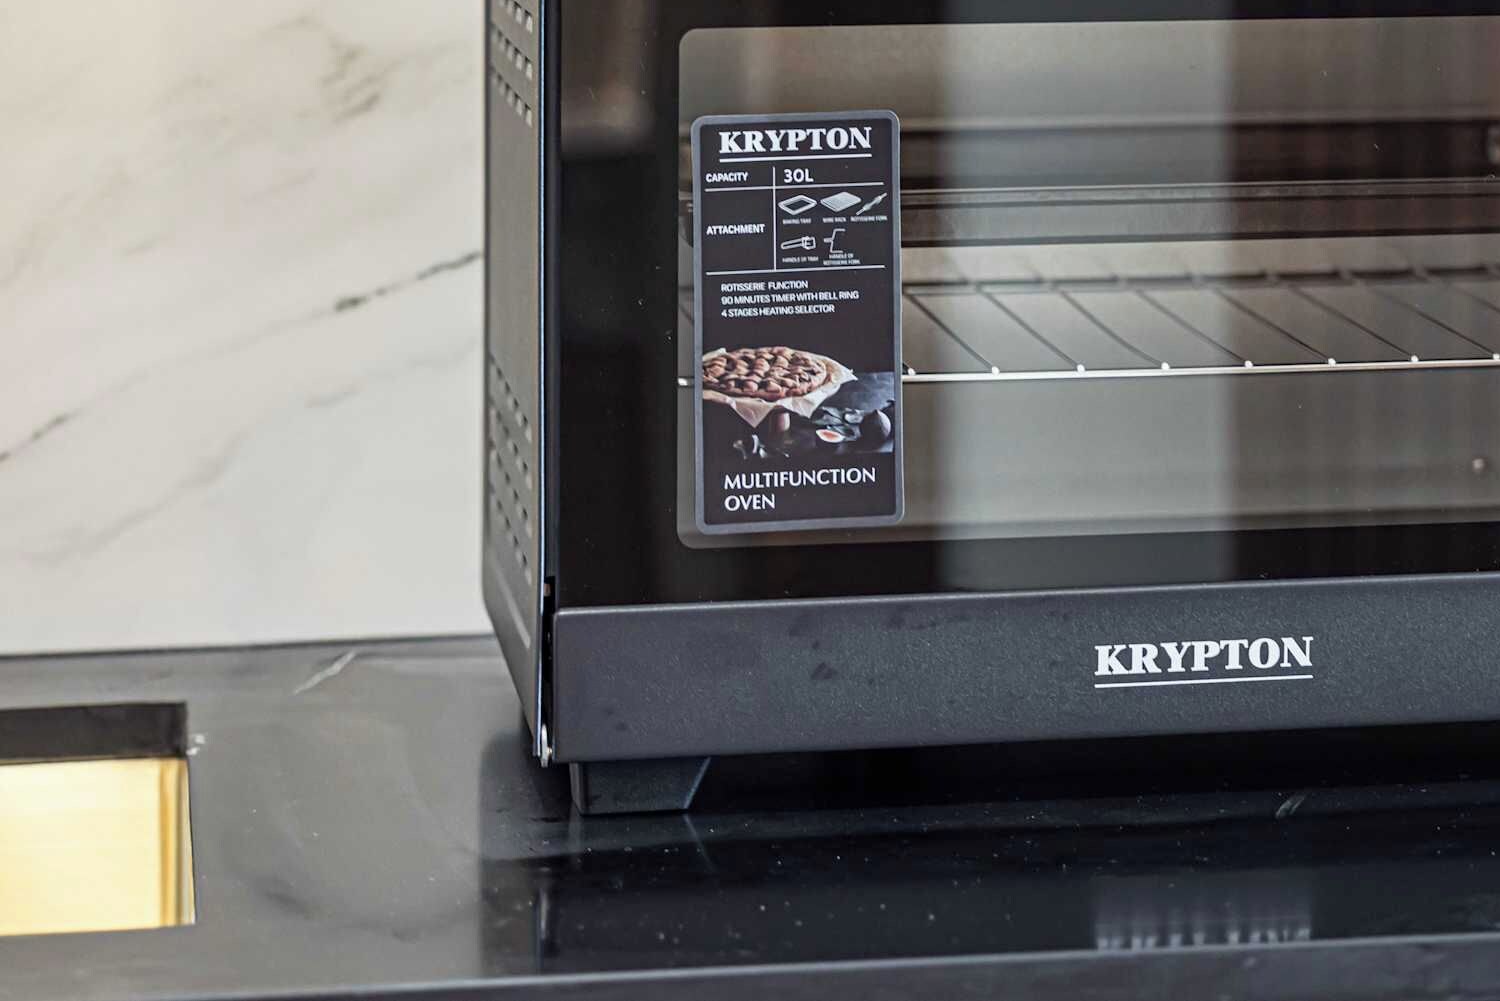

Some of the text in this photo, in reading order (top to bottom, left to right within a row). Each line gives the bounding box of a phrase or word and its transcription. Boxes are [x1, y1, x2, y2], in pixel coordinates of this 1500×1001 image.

[718, 126, 872, 154] KRYPTON
[705, 172, 748, 183] CAPACITY
[783, 168, 814, 183] 30L
[706, 223, 766, 236] ATTACHMENT
[721, 280, 809, 292] ROTISSERIE FUNCTION
[721, 290, 860, 305] 90 MINUTES TIMER WITH BELL RING
[721, 304, 836, 318] 4 STAGES HEATING SELECTOR
[724, 467, 876, 490] MULTIFUNCTION
[724, 494, 776, 512] OVEN
[1094, 636, 1314, 676] KRYPTON
